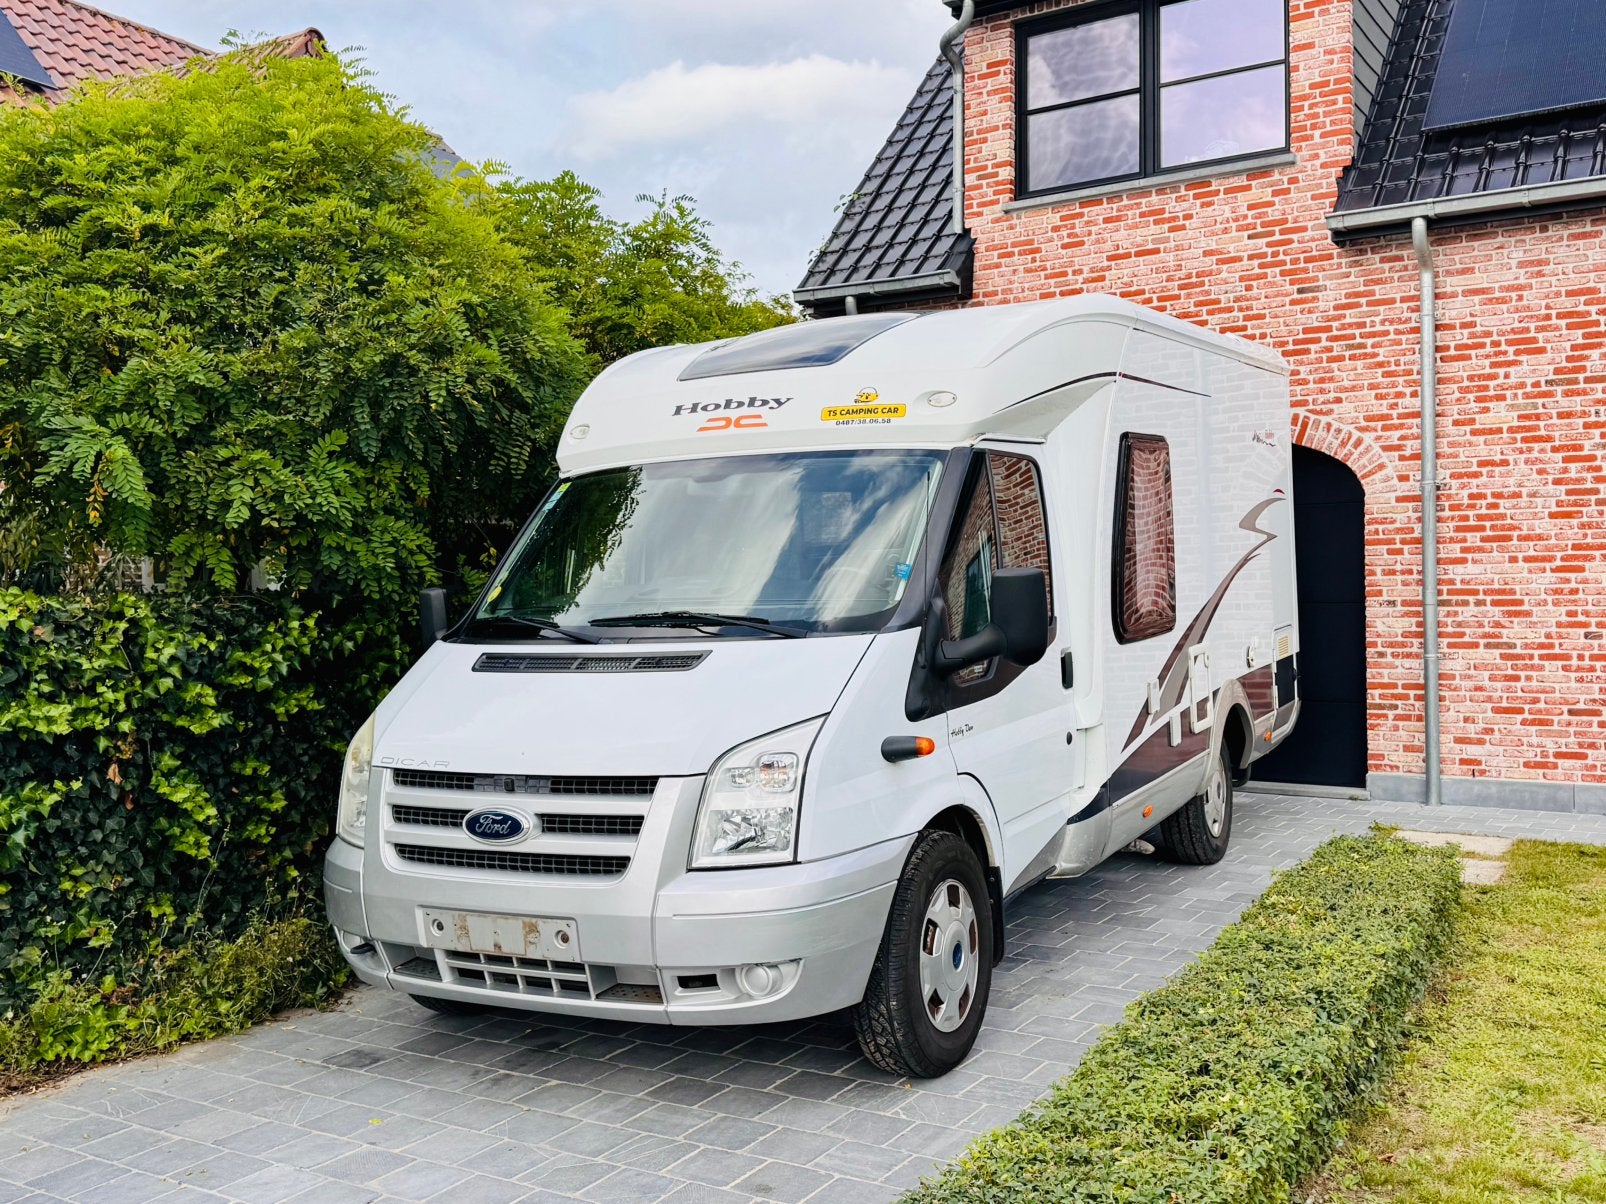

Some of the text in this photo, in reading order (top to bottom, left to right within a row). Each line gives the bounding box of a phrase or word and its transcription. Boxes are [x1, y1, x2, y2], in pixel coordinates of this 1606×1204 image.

[672, 397, 794, 416] Hobby
[839, 407, 879, 416] CAMPING
[380, 756, 450, 768] DICAR
[475, 814, 512, 834] Ford
